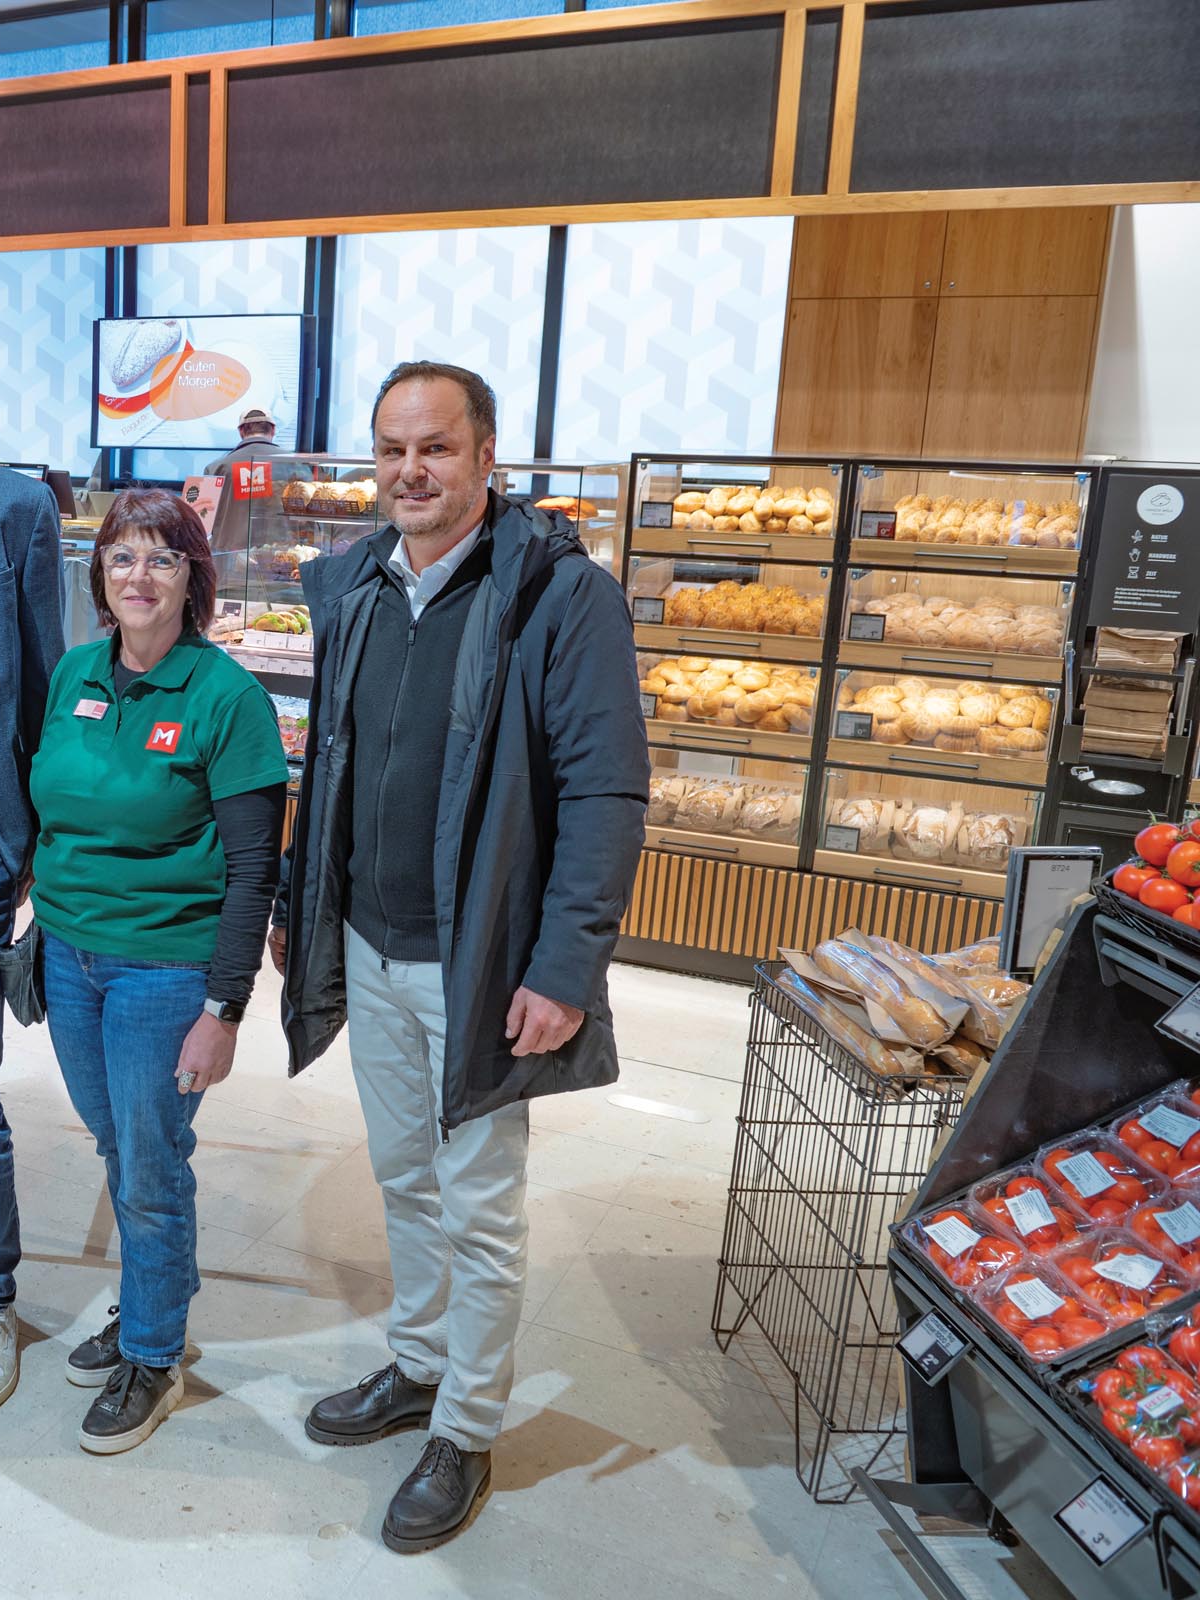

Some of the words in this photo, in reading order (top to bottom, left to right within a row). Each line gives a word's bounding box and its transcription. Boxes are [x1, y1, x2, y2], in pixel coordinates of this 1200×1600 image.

[183, 360, 216, 373] Guten
[178, 375, 220, 388] Morgen
[152, 727, 176, 746] M
